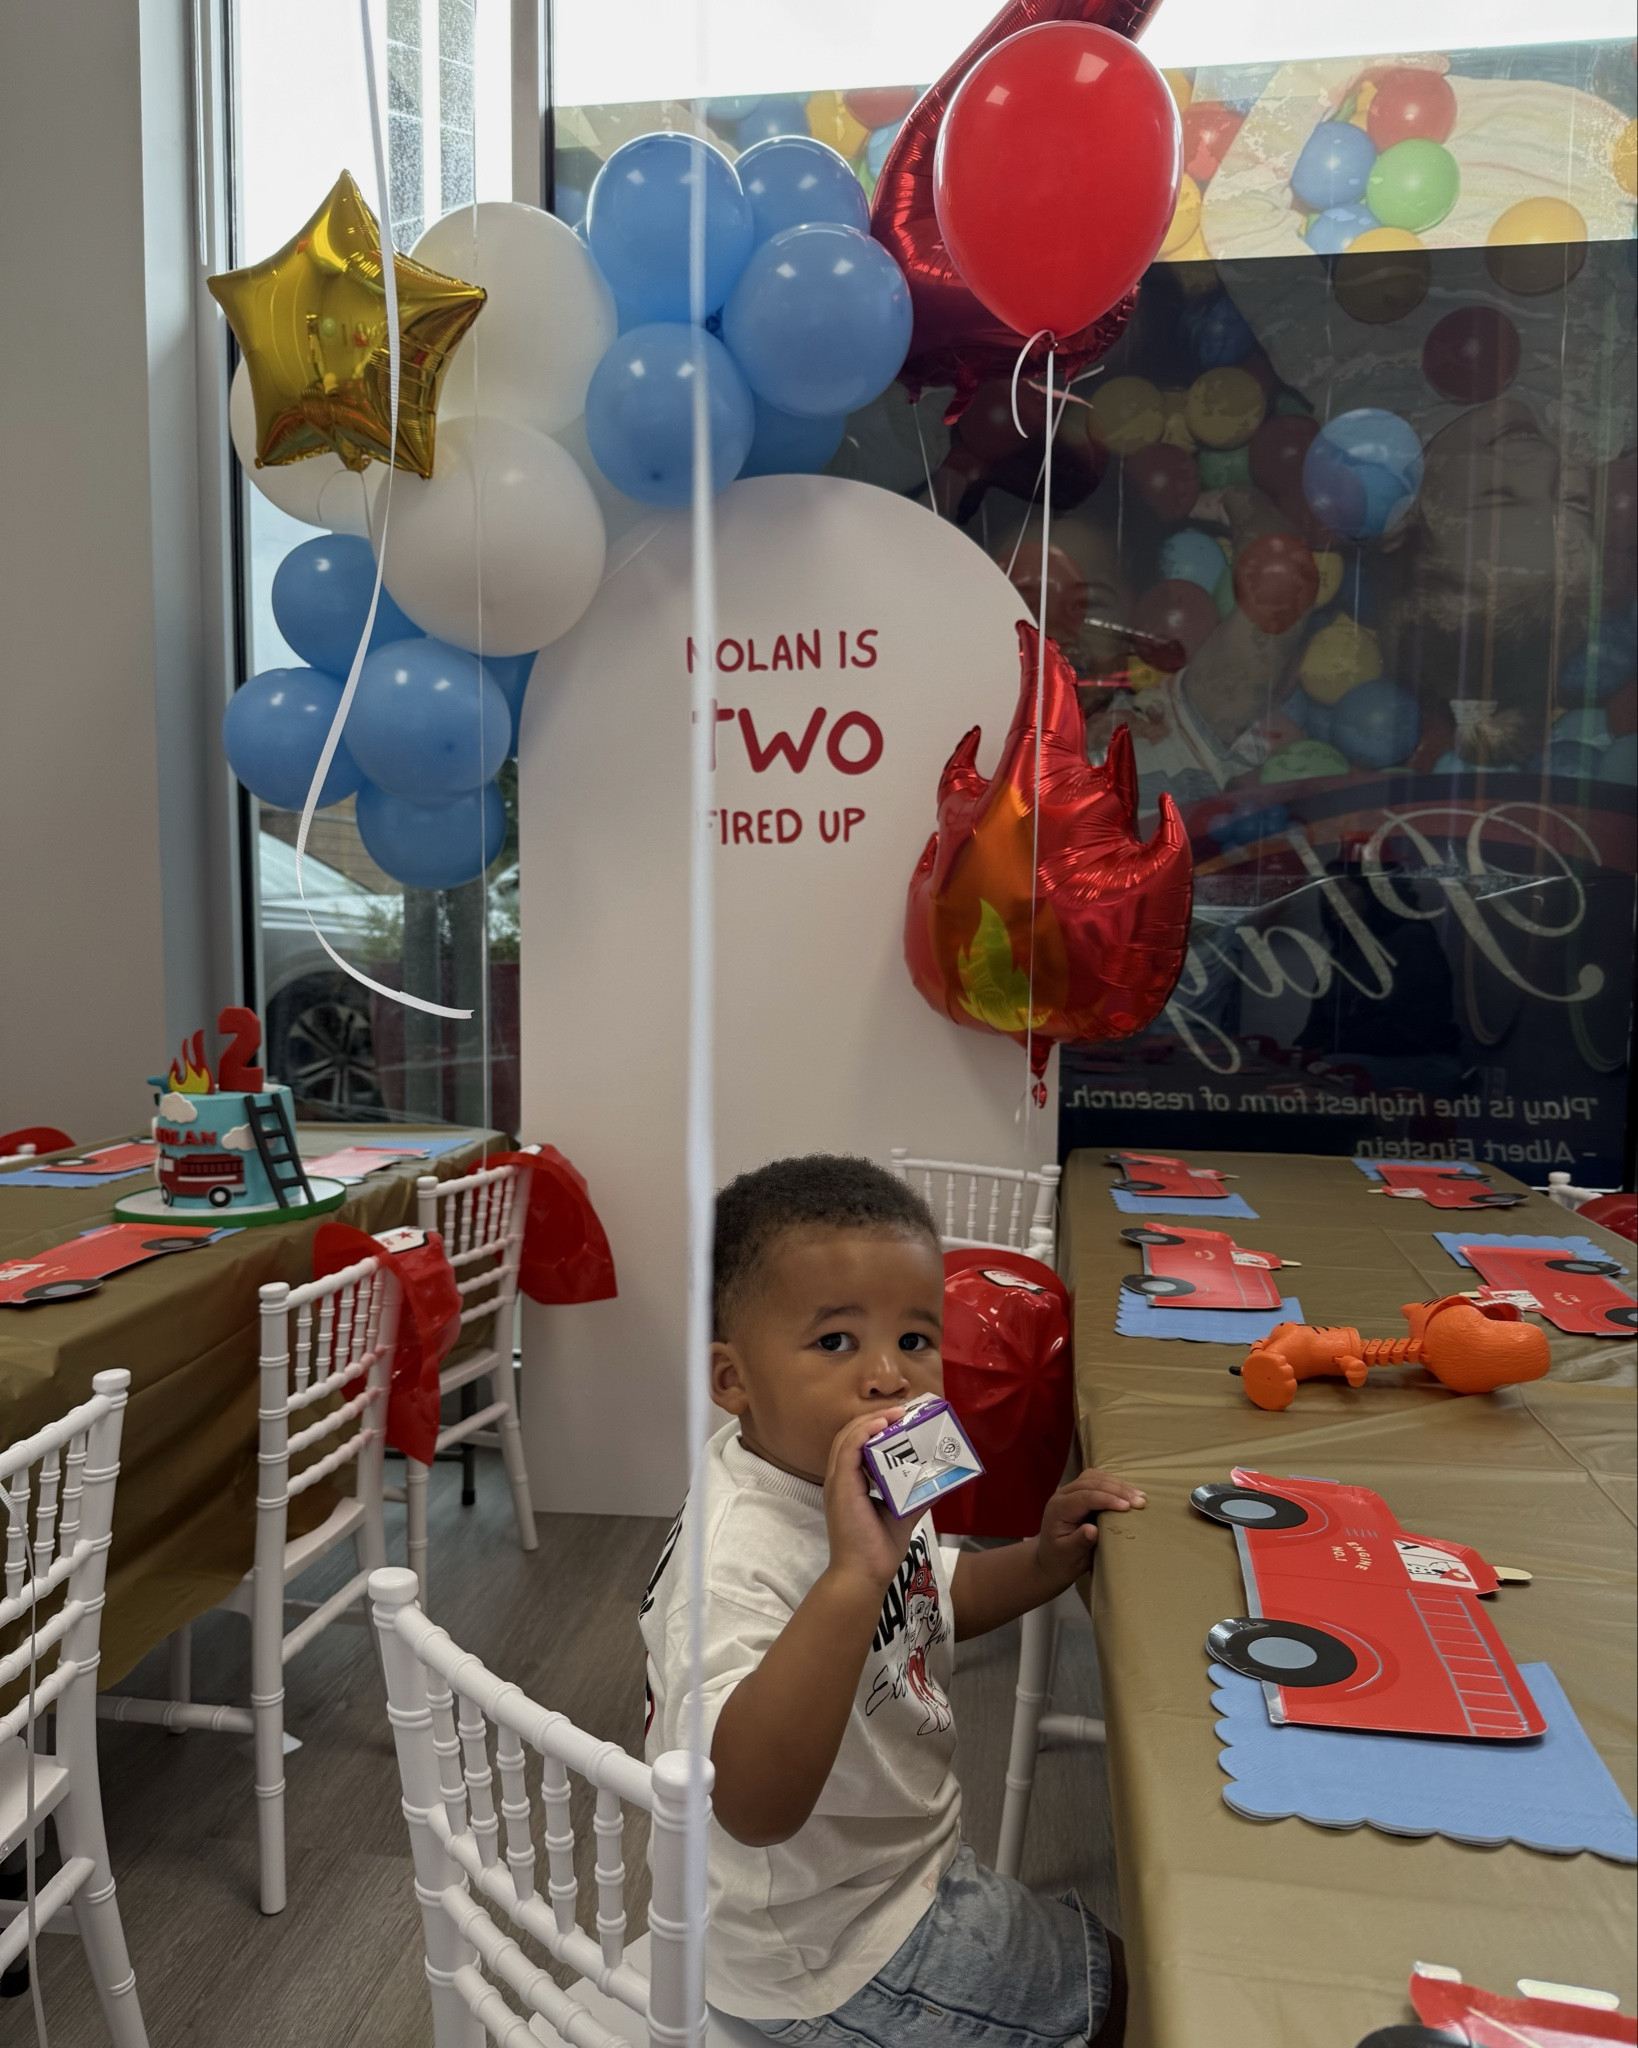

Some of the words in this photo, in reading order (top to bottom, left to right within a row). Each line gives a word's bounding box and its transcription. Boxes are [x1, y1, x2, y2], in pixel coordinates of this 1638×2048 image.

[839, 629, 878, 669] IS
[819, 808, 866, 843] UP
[218, 1006, 264, 1094] 2
[1346, 1541, 1372, 1570] ENGINE
